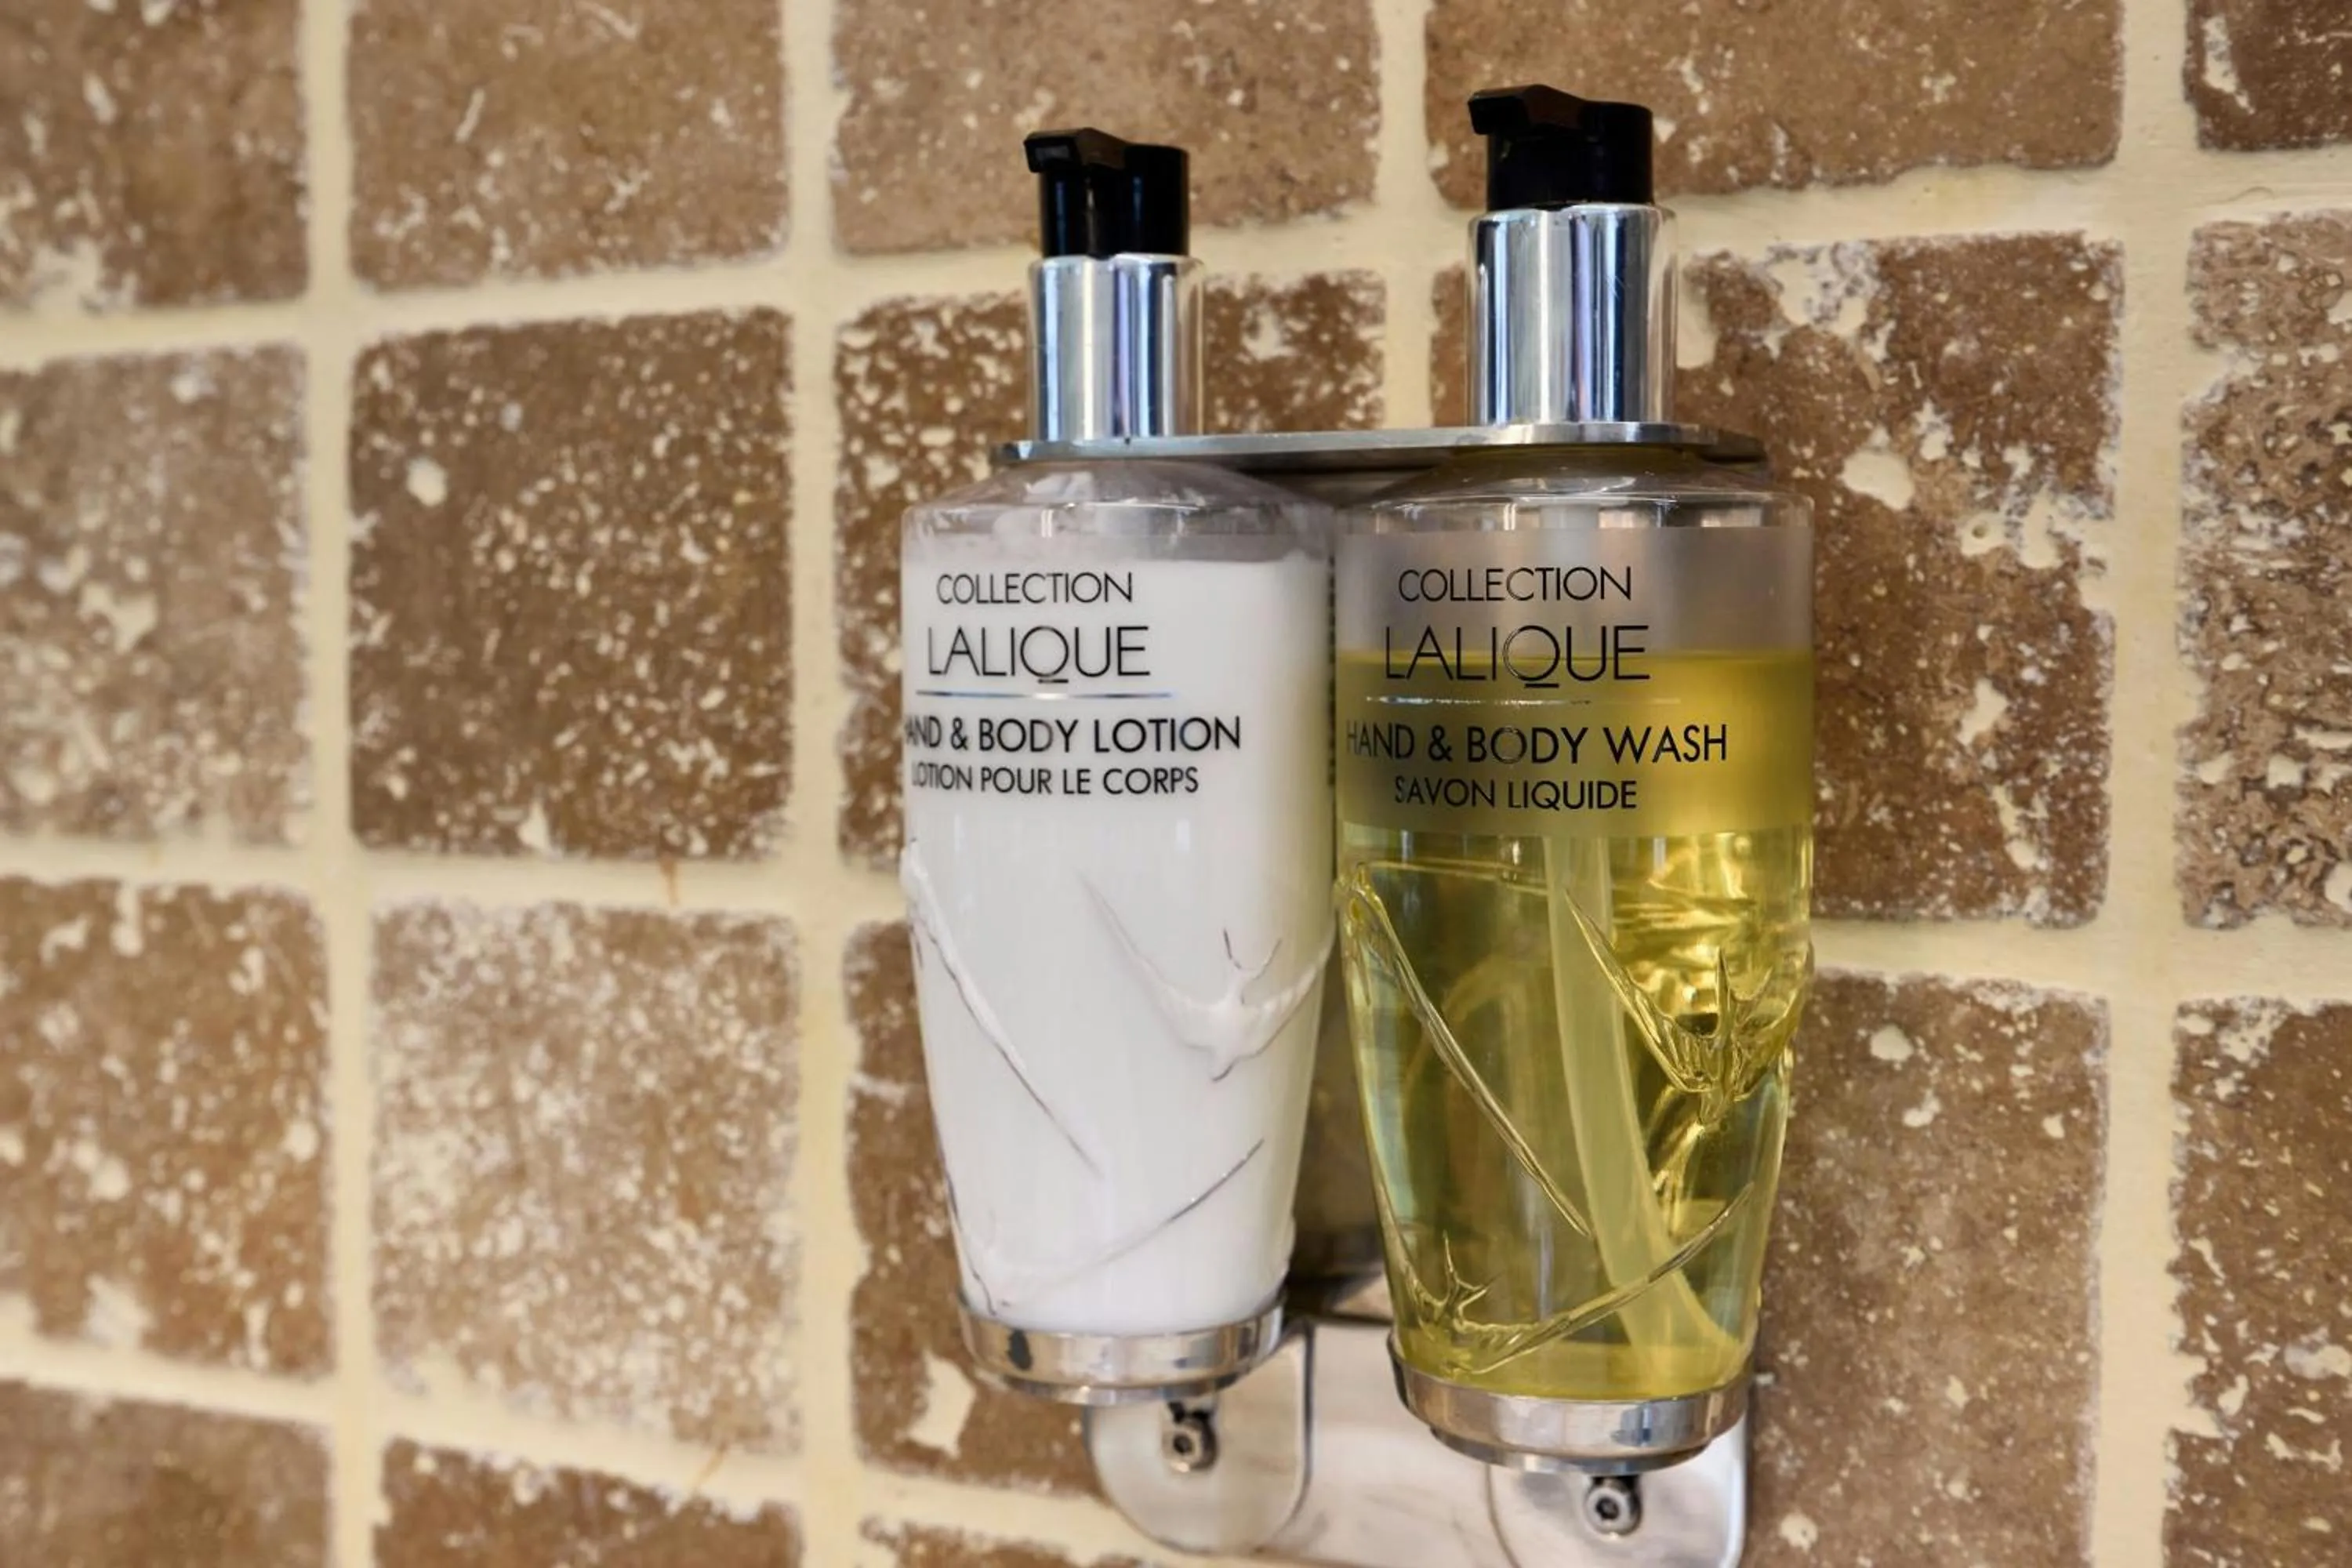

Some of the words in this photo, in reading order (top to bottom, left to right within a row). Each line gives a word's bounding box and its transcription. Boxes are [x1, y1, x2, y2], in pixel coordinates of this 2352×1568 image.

[936, 572, 1134, 604] COLLECTION
[1399, 565, 1632, 602] COLLECTION
[927, 626, 1152, 684] LALIQUE
[1385, 625, 1650, 688] LALIQUE
[903, 716, 942, 749] AND
[950, 717, 969, 750] &
[978, 718, 1079, 753] BODY
[1094, 716, 1241, 753] LOTION
[1346, 720, 1414, 760] HAND
[1428, 724, 1454, 762] &
[1467, 726, 1588, 765] BODY
[1602, 724, 1727, 764] WASH
[912, 762, 973, 791] LOTION
[980, 767, 1052, 795] POUR
[1062, 768, 1091, 795] LE
[1102, 767, 1199, 795] CORPS
[1394, 776, 1495, 809] SAVON
[1507, 780, 1637, 811] LIQUIDE
